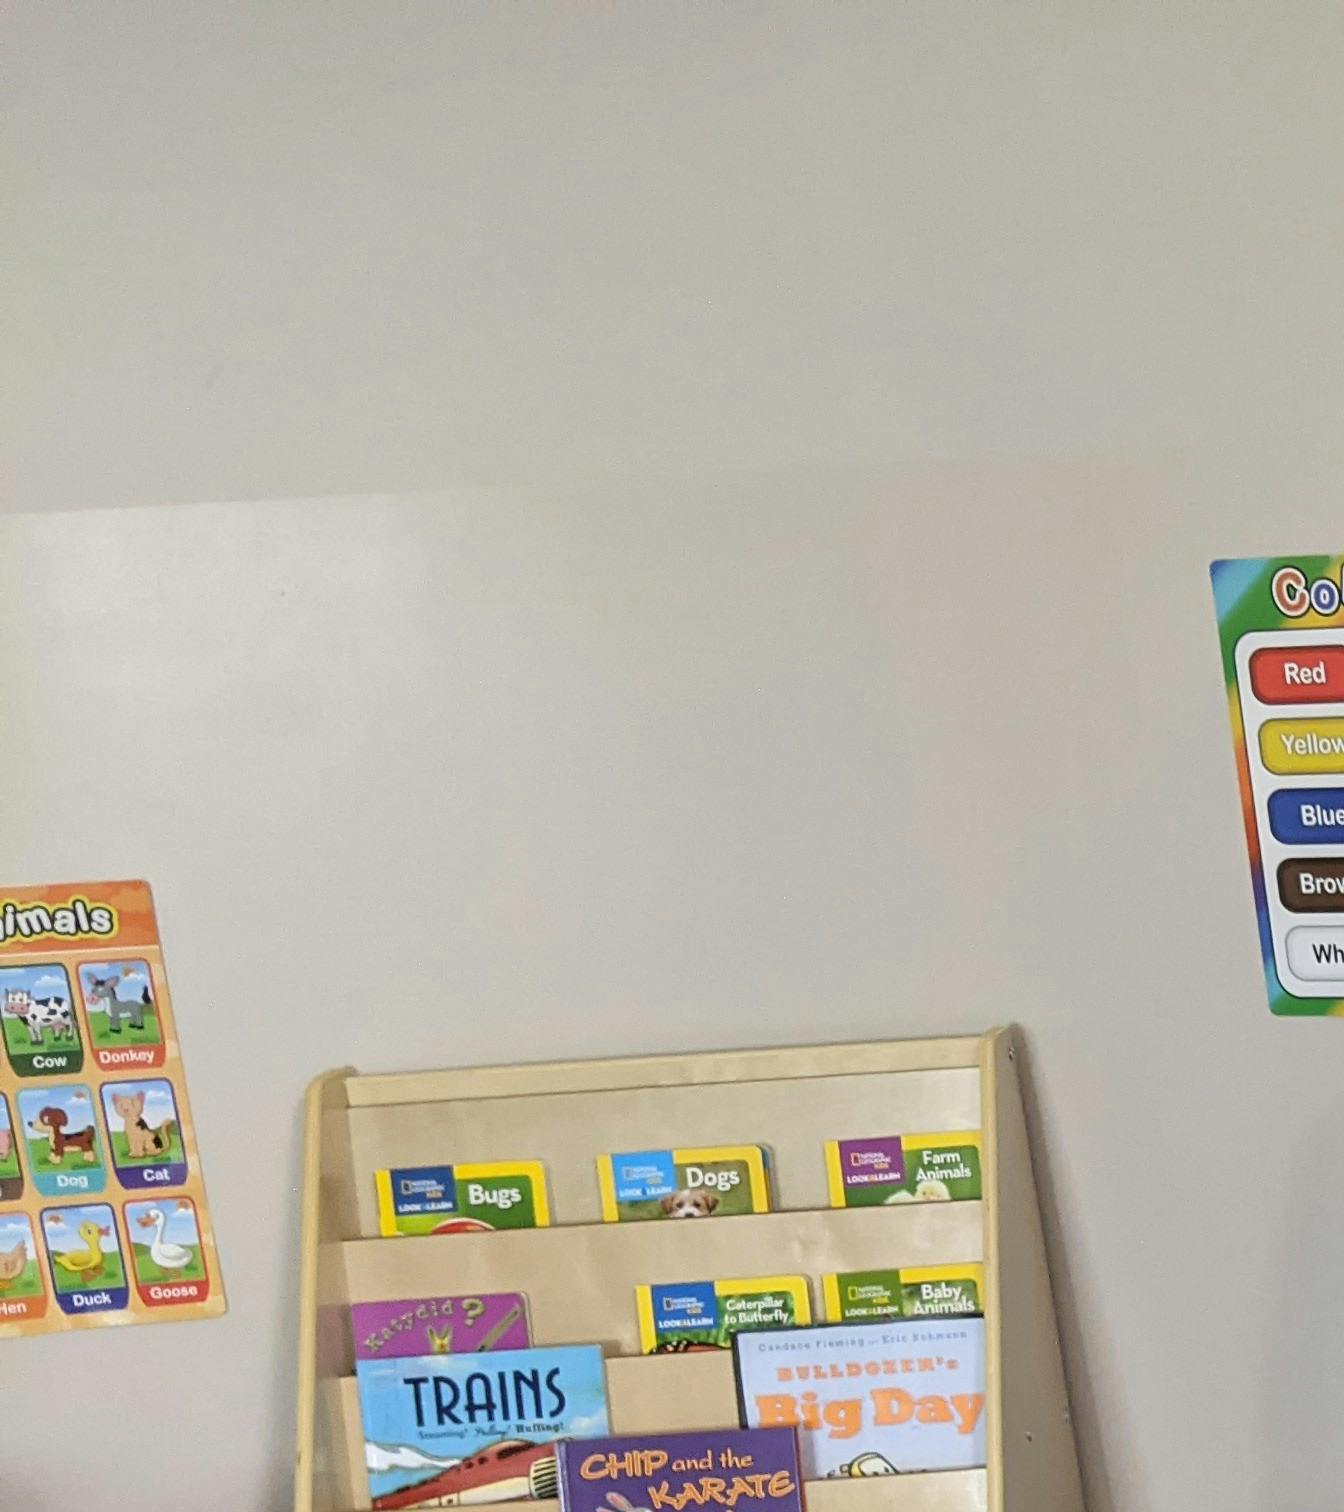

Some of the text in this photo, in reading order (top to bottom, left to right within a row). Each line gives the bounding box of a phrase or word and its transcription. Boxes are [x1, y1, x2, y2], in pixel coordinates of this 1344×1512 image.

[1284, 663, 1326, 684] Red
[0, 899, 113, 941] imals
[33, 1055, 67, 1068] Cow
[100, 1049, 155, 1064] Donkey
[922, 1150, 961, 1165] Farm
[144, 1168, 169, 1182] Cat
[686, 1166, 740, 1190] Dogs
[915, 1164, 972, 1182] Animals
[57, 1174, 88, 1190] Dog
[468, 1184, 522, 1208] Bugs
[73, 1292, 112, 1306] Duck
[150, 1285, 198, 1298] Goose
[921, 1283, 961, 1300] Baby
[726, 1298, 784, 1313] Caterpillar
[913, 1298, 975, 1315] Animals
[725, 1310, 789, 1324] to Butterfly
[404, 1367, 566, 1427] TRAINS
[755, 1388, 985, 1438] Big Day
[580, 1448, 753, 1480] CHIP and the
[648, 1470, 795, 1510] KARATE
